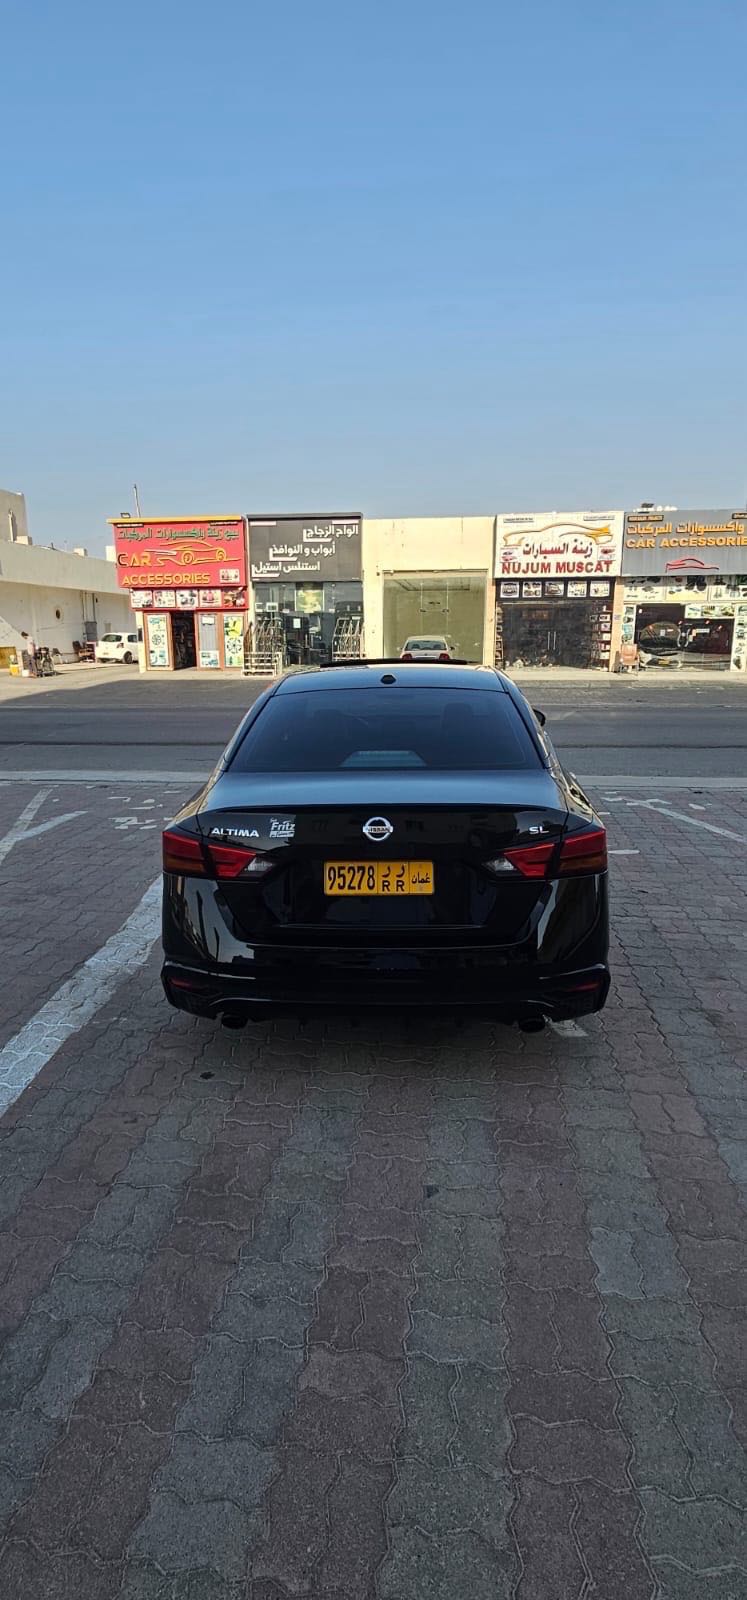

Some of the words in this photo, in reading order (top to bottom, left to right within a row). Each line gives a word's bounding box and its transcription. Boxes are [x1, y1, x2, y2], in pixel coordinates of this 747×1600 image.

[118, 528, 153, 542] المركبات
[307, 525, 335, 538] الزجاج
[336, 525, 359, 538] الواح
[627, 522, 672, 537] المركبات
[311, 541, 336, 557] أبواب
[626, 538, 656, 549] CAR
[272, 544, 303, 557] النوافذ
[304, 548, 311, 557] و
[522, 543, 569, 559] السيارات
[117, 552, 152, 567] CAR
[254, 561, 282, 573] استيل
[501, 562, 551, 574] NUJUM
[555, 560, 613, 574] MUSCAT
[122, 573, 211, 586] ACCESSORIES
[211, 827, 260, 838] ALTIMA
[271, 821, 296, 831] Fritz
[528, 825, 550, 835] SL
[327, 865, 376, 891] 95278
